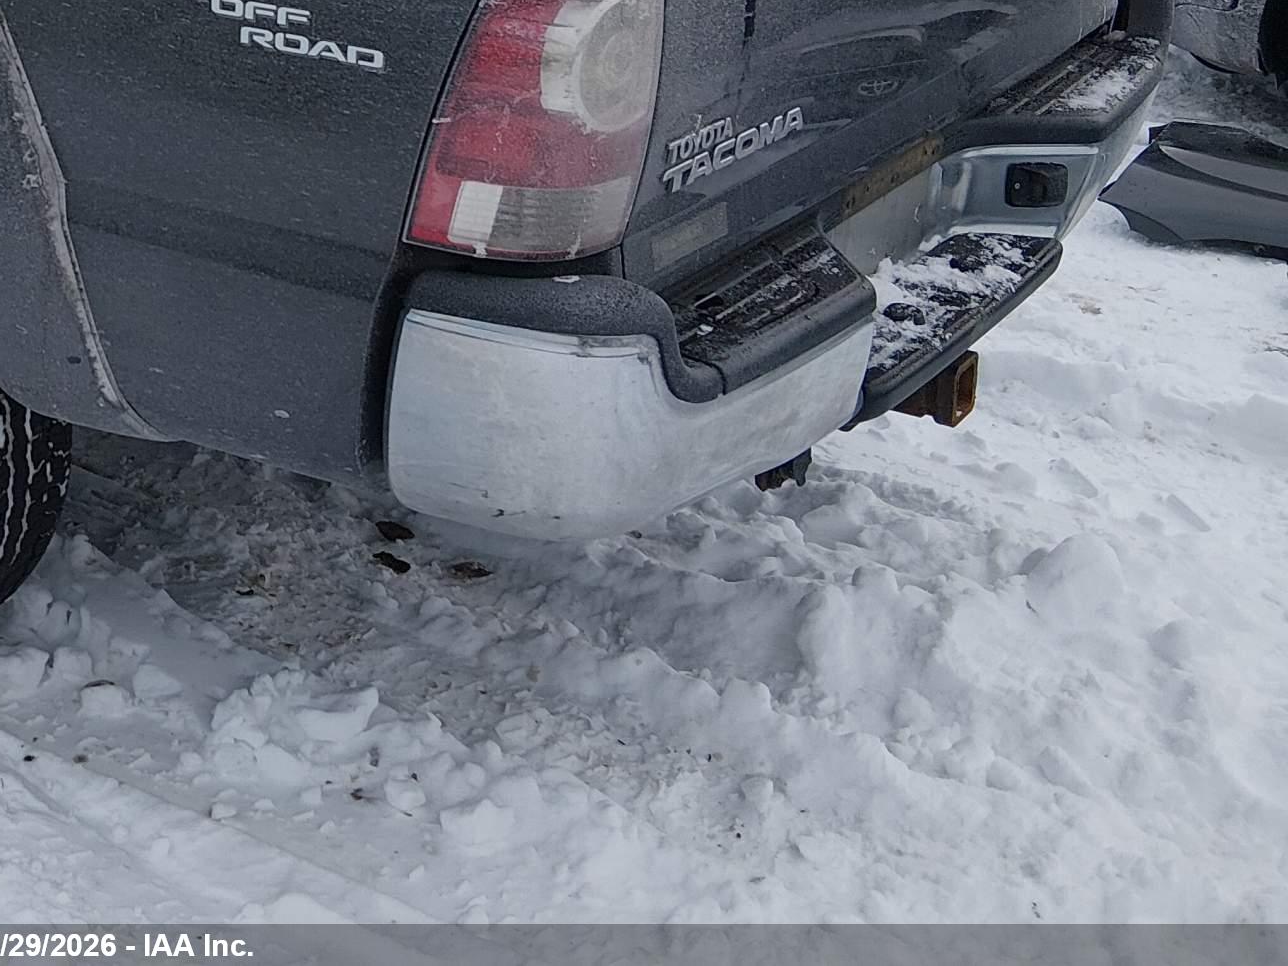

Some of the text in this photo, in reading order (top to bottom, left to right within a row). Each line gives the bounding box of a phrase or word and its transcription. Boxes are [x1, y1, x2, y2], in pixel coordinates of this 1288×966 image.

[240, 27, 385, 70] ROAD
[663, 107, 805, 193] TACOMA
[668, 117, 734, 164] TOYOTA
